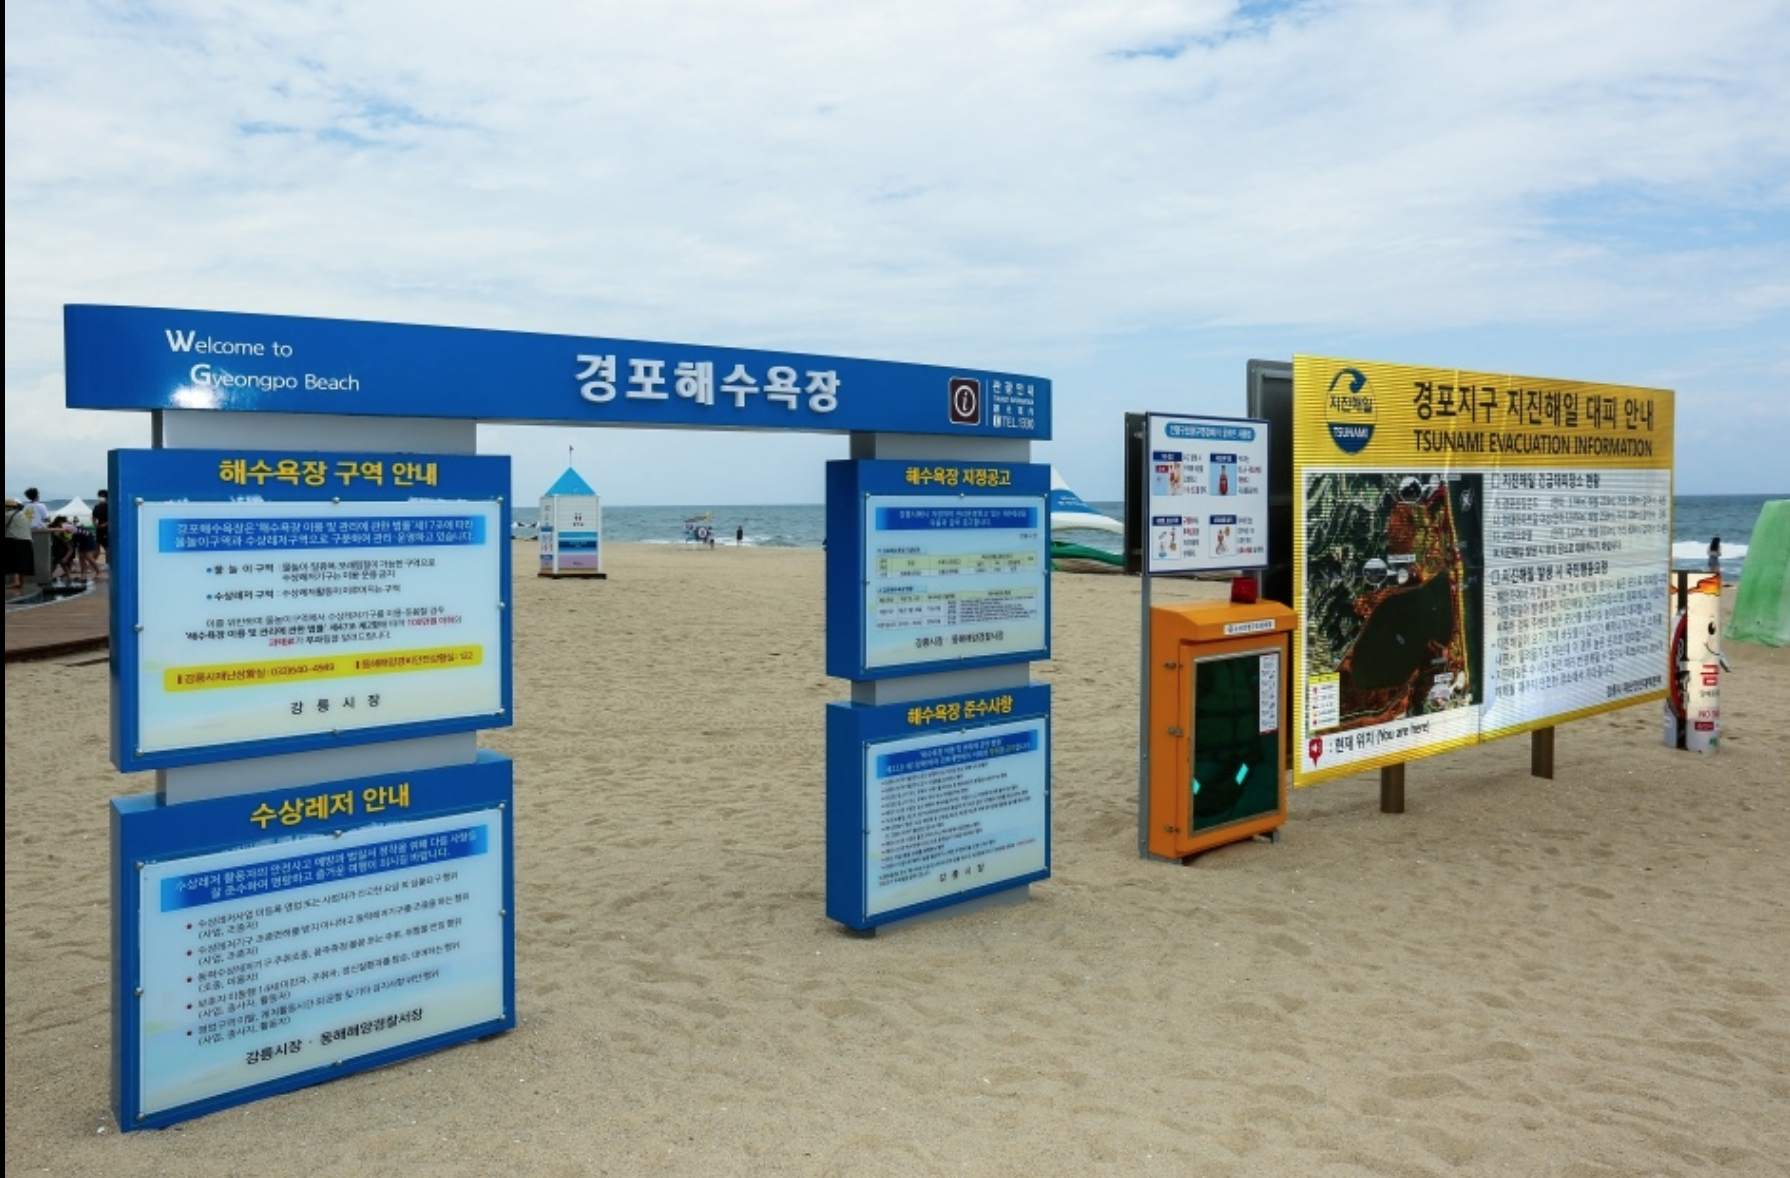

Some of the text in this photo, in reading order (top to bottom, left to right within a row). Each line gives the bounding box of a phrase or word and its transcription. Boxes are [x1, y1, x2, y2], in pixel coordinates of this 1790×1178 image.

[165, 329, 293, 357] Welcome to
[190, 363, 359, 391] Gyeongpo Beach
[575, 354, 841, 413] 경포해수욕장
[1413, 381, 1654, 431] 경포지구 지진해일 대피 안내
[1333, 426, 1369, 438] TSUNAMI
[1413, 429, 1653, 457] TSUNAMI EVACUATION INFORMATION
[219, 459, 438, 486] 해수욕장 구역 안내
[905, 467, 1011, 487] 해수욕장 지정공고
[907, 694, 1014, 726] 해수욕장 준수사항
[250, 783, 411, 829] 수상레저 안내
[245, 1038, 303, 1065] 강릉시장
